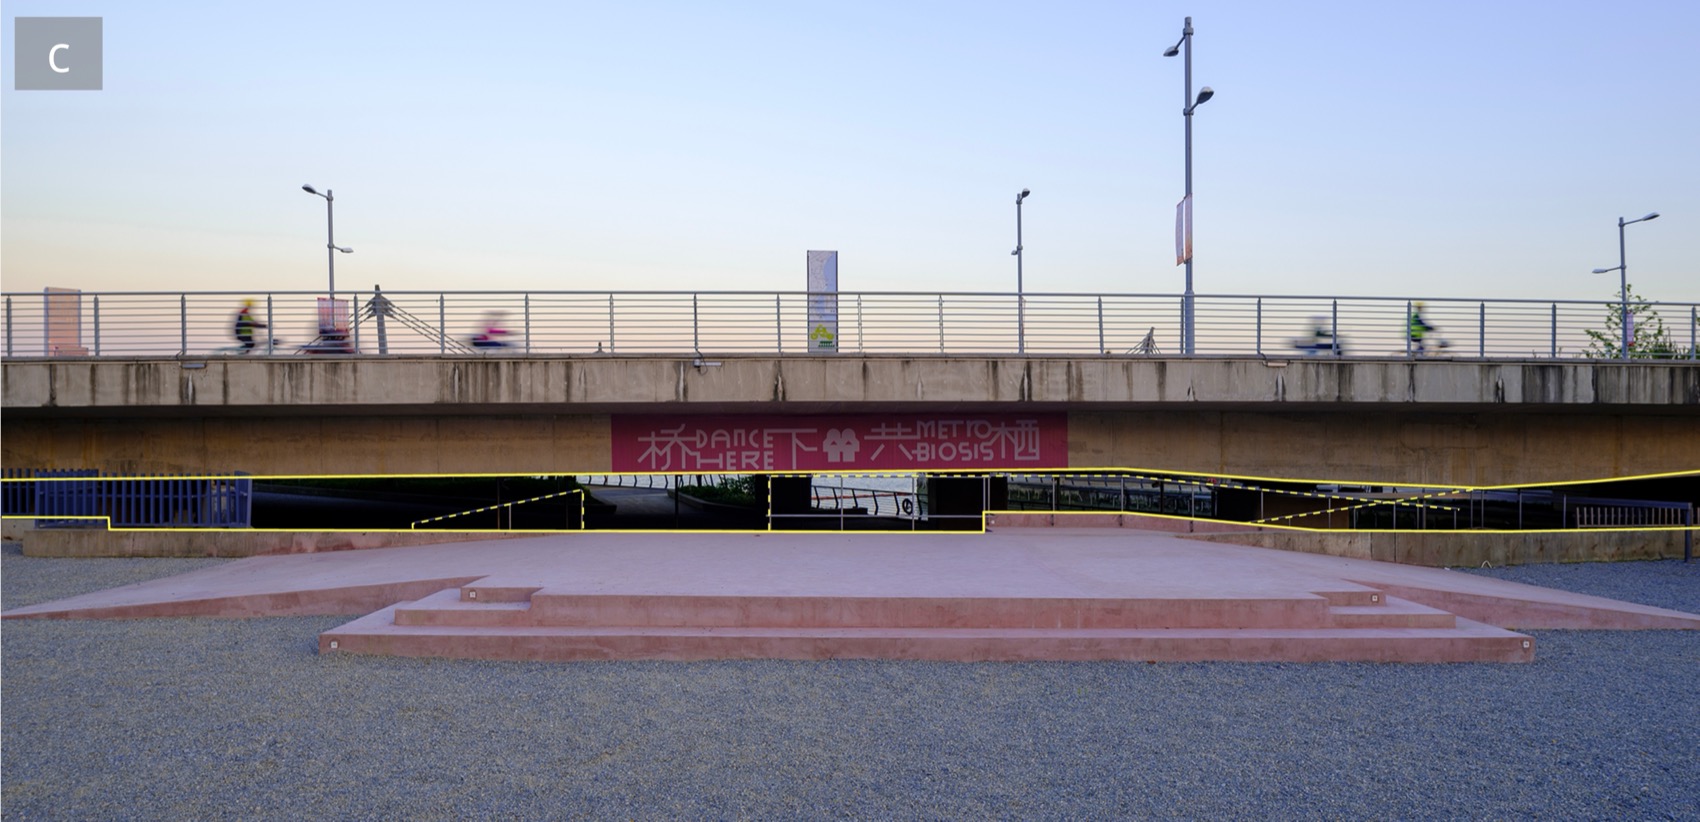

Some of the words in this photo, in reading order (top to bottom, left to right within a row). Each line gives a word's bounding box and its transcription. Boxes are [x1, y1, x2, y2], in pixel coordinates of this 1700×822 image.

[696, 429, 773, 448] DANCE
[697, 451, 773, 470] HERE
[916, 442, 994, 461] BIOSIS
